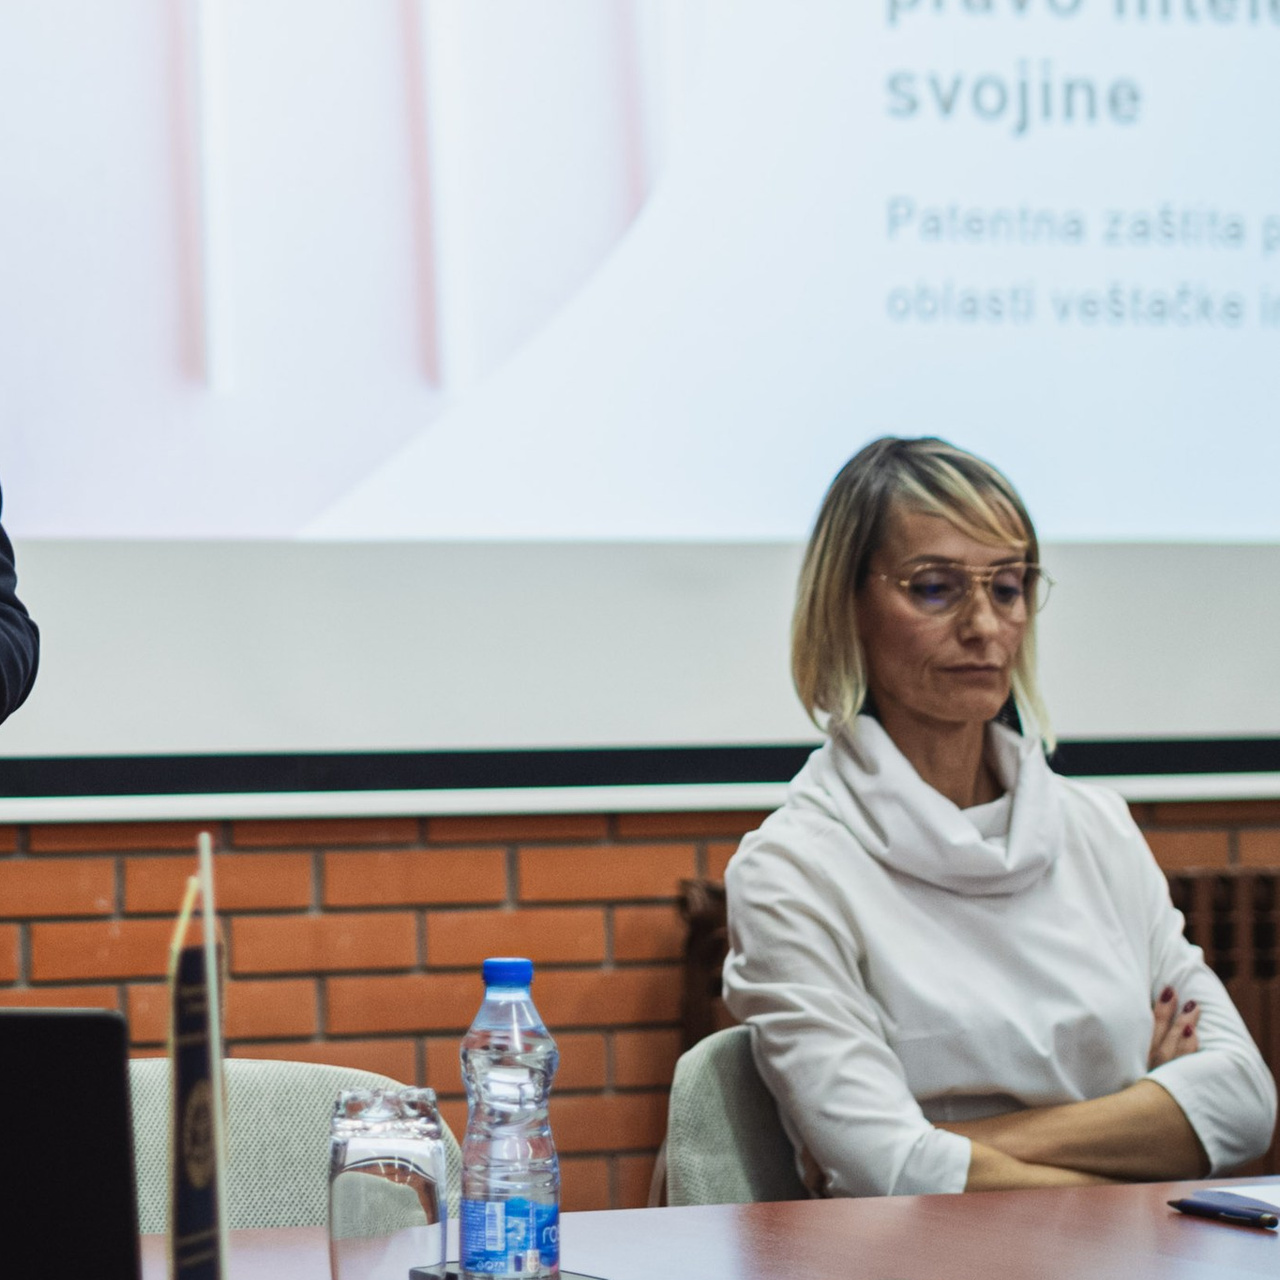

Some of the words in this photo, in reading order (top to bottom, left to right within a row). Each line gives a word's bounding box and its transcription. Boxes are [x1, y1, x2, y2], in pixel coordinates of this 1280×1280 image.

[886, 58, 1141, 137] svojine
[886, 195, 1086, 244] Patentna
[1102, 201, 1246, 249] zaštita
[886, 280, 1035, 324] oblasti
